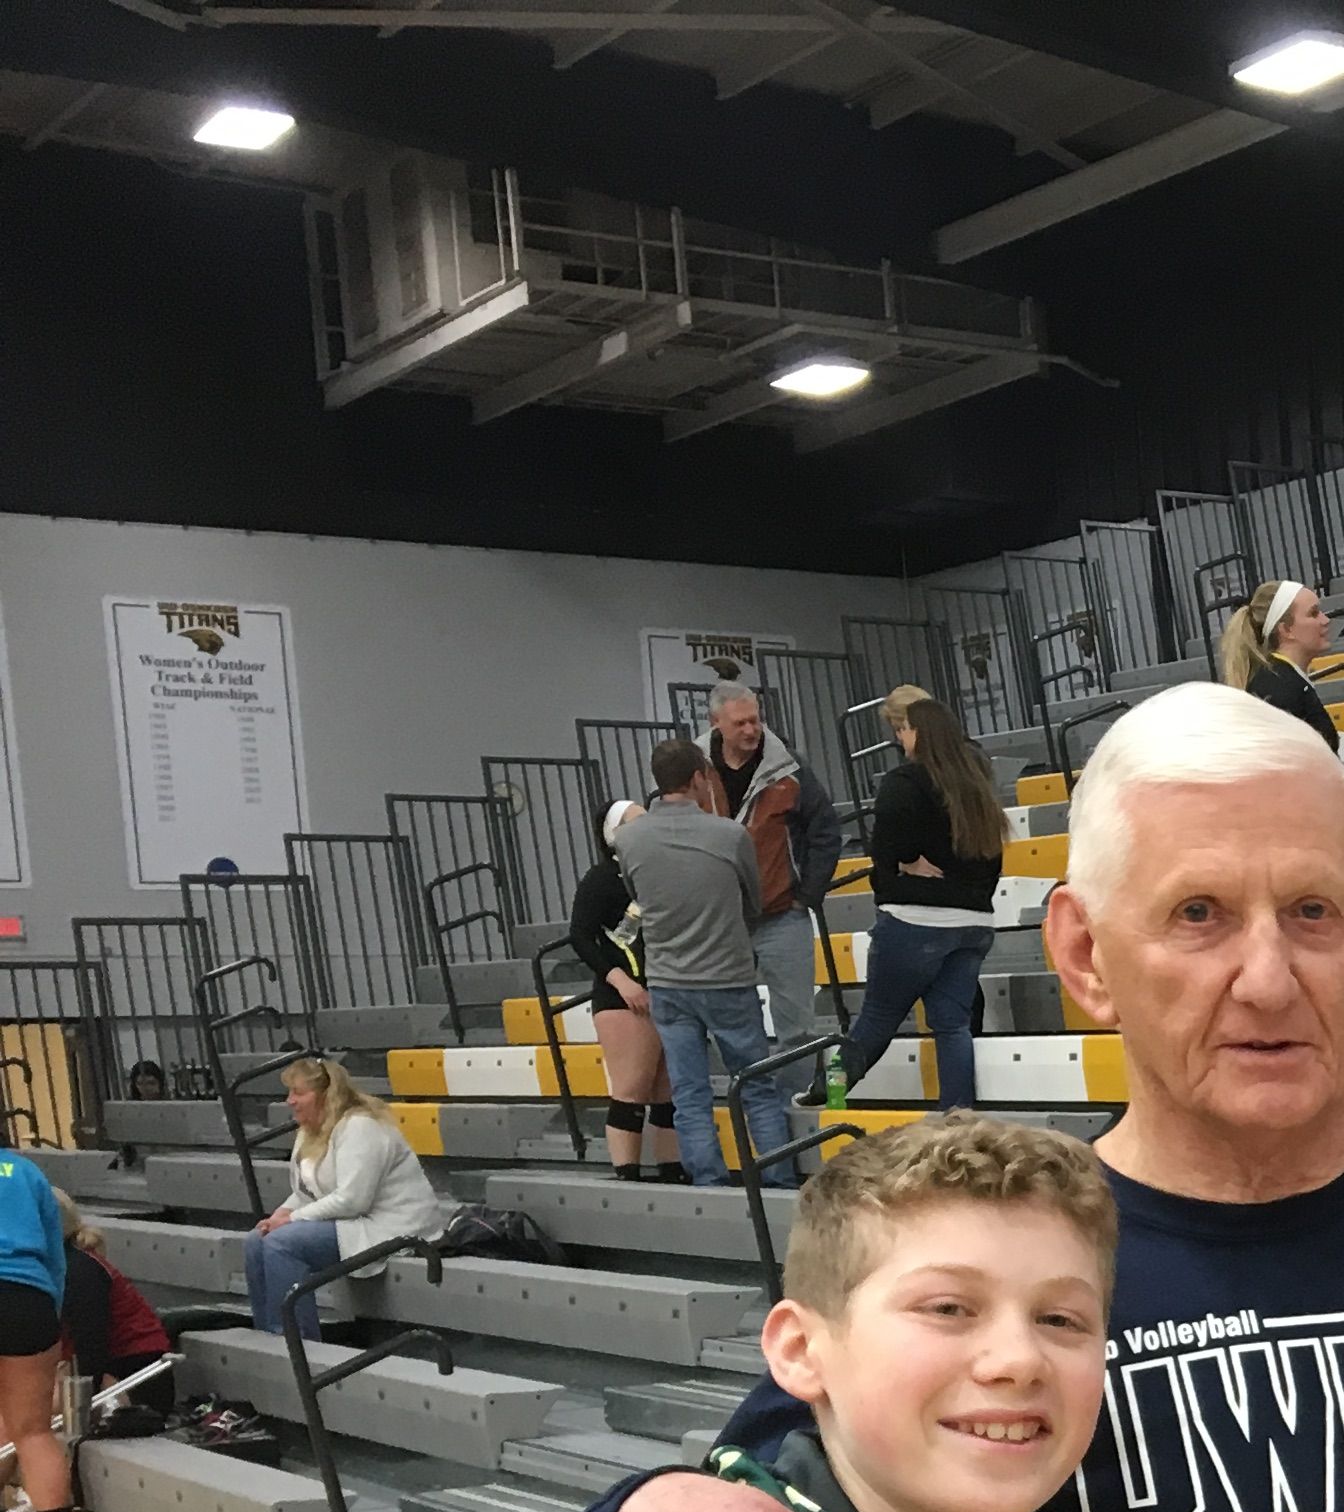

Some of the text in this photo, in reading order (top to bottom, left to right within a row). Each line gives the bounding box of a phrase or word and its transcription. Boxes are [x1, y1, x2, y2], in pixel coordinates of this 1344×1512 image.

[158, 611, 241, 639] TITANS
[139, 654, 266, 672] Women's Outdoor
[686, 642, 754, 667] TITANS
[157, 670, 253, 686] Track & Field
[151, 684, 259, 703] Championships
[1123, 1309, 1260, 1354] Volleyball
